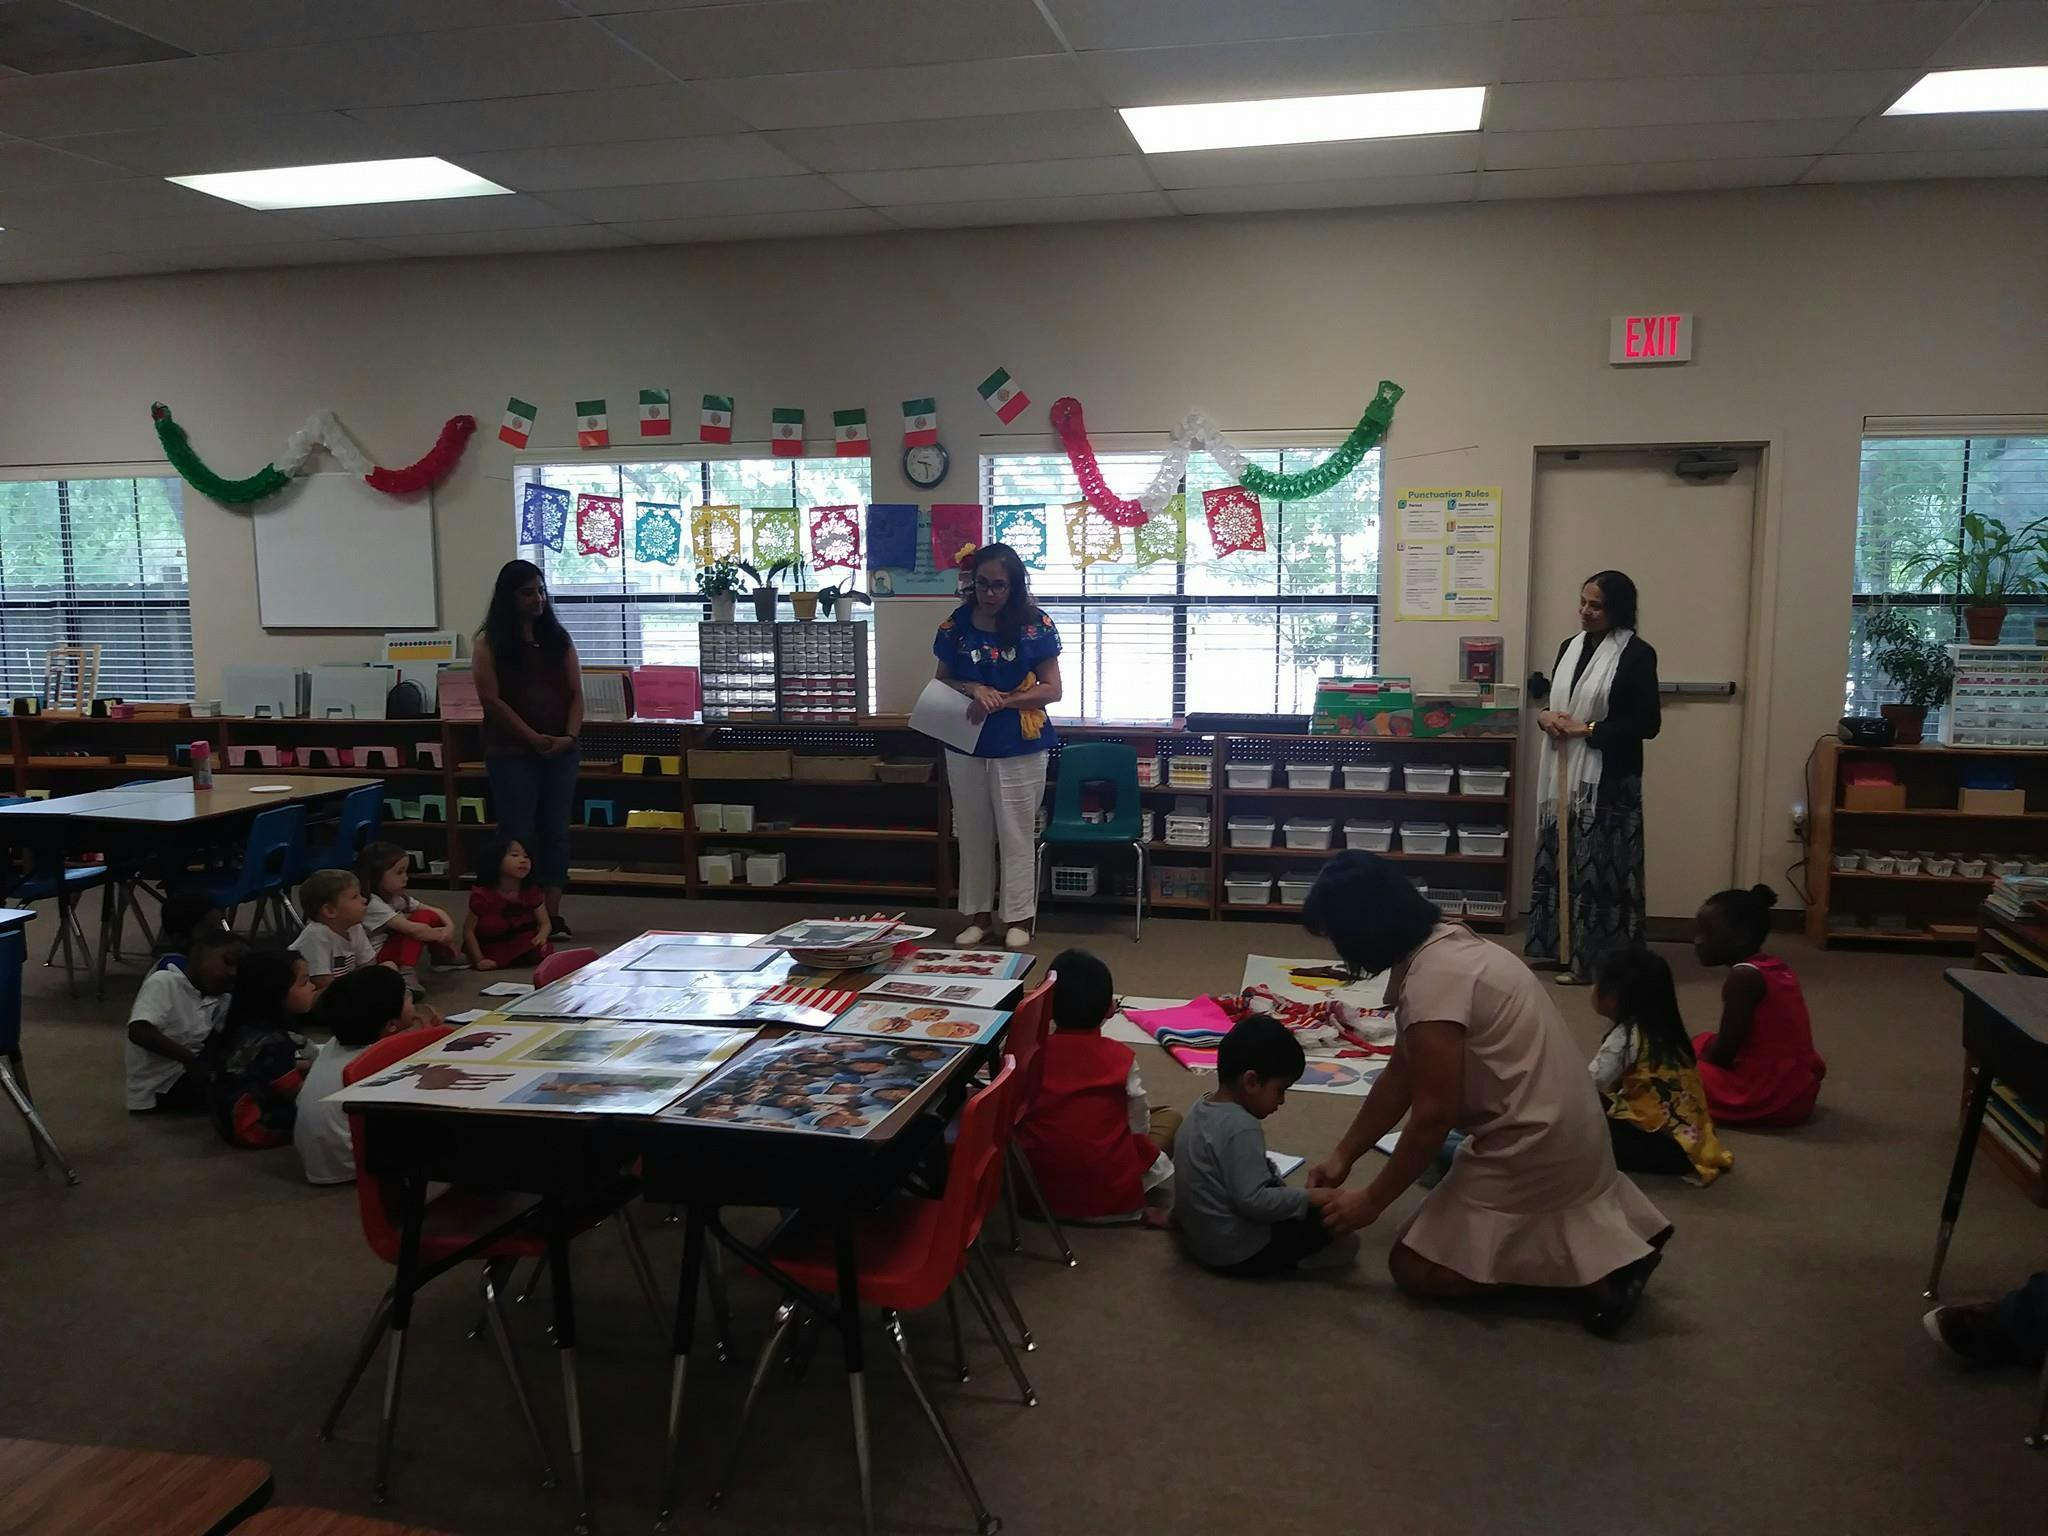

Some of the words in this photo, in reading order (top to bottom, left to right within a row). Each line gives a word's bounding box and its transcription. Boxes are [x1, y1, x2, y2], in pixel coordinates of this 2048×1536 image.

[1625, 316, 1681, 357] EXIT
[1408, 490, 1462, 498] Punctuation
[1465, 489, 1489, 498] Rules
